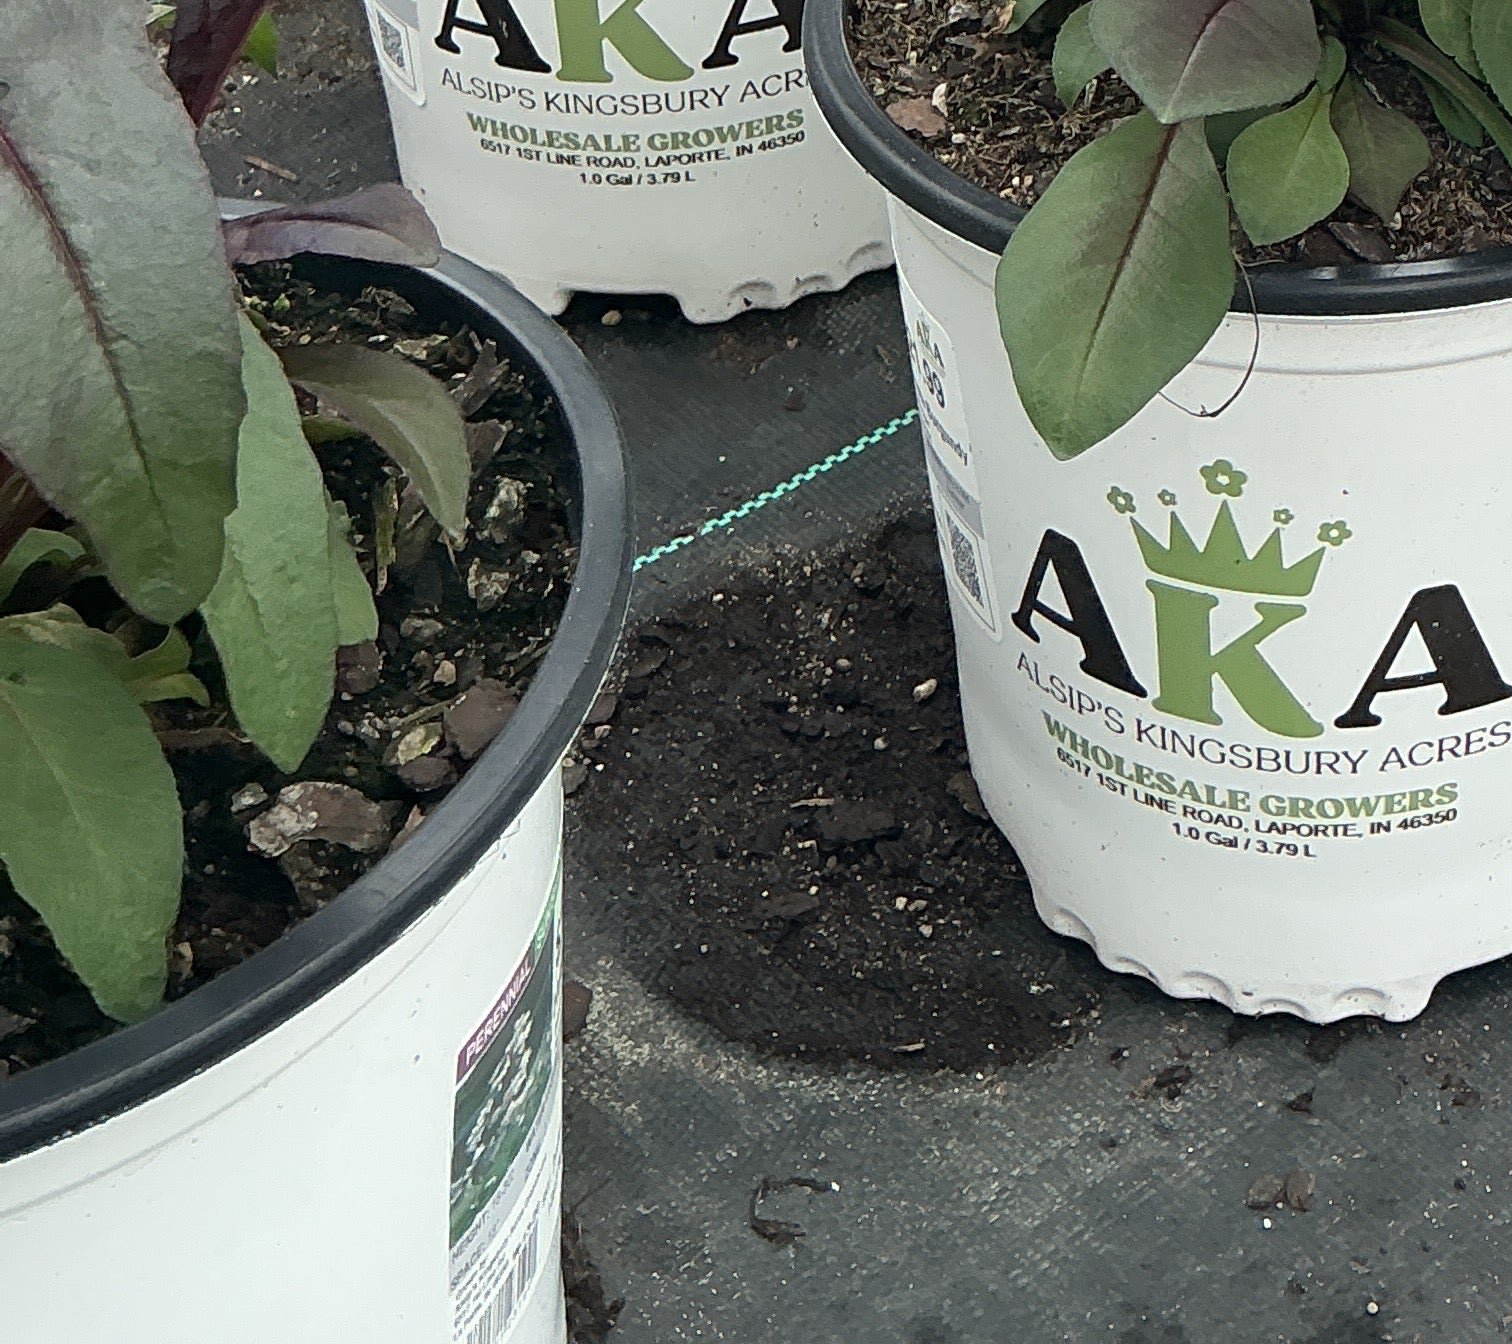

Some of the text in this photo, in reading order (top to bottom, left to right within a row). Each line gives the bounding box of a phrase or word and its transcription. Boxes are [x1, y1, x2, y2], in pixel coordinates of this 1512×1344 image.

[442, 67, 809, 116] ALSIP'S KINGSBURY ACR
[465, 108, 805, 153] WHOLESALE GROWERS
[480, 129, 806, 170] 6517 1ST LINE ROAD, LAPORTE, IN 46350
[579, 172, 603, 185] 1.0
[605, 172, 633, 186] Gal
[646, 171, 682, 186] 3.79
[684, 170, 696, 183] L
[1016, 651, 1512, 775] ALSIP'S KINGSBURY ACRES
[1041, 709, 1459, 820] WHOLESALE GROWERS
[1056, 747, 1459, 839] 6517 1ST LINE ROAD, LAPORTE, IN 46350
[1172, 821, 1317, 858] 1.0 Gal / 3.79 L
[464, 956, 532, 1068] PERENNIAL
